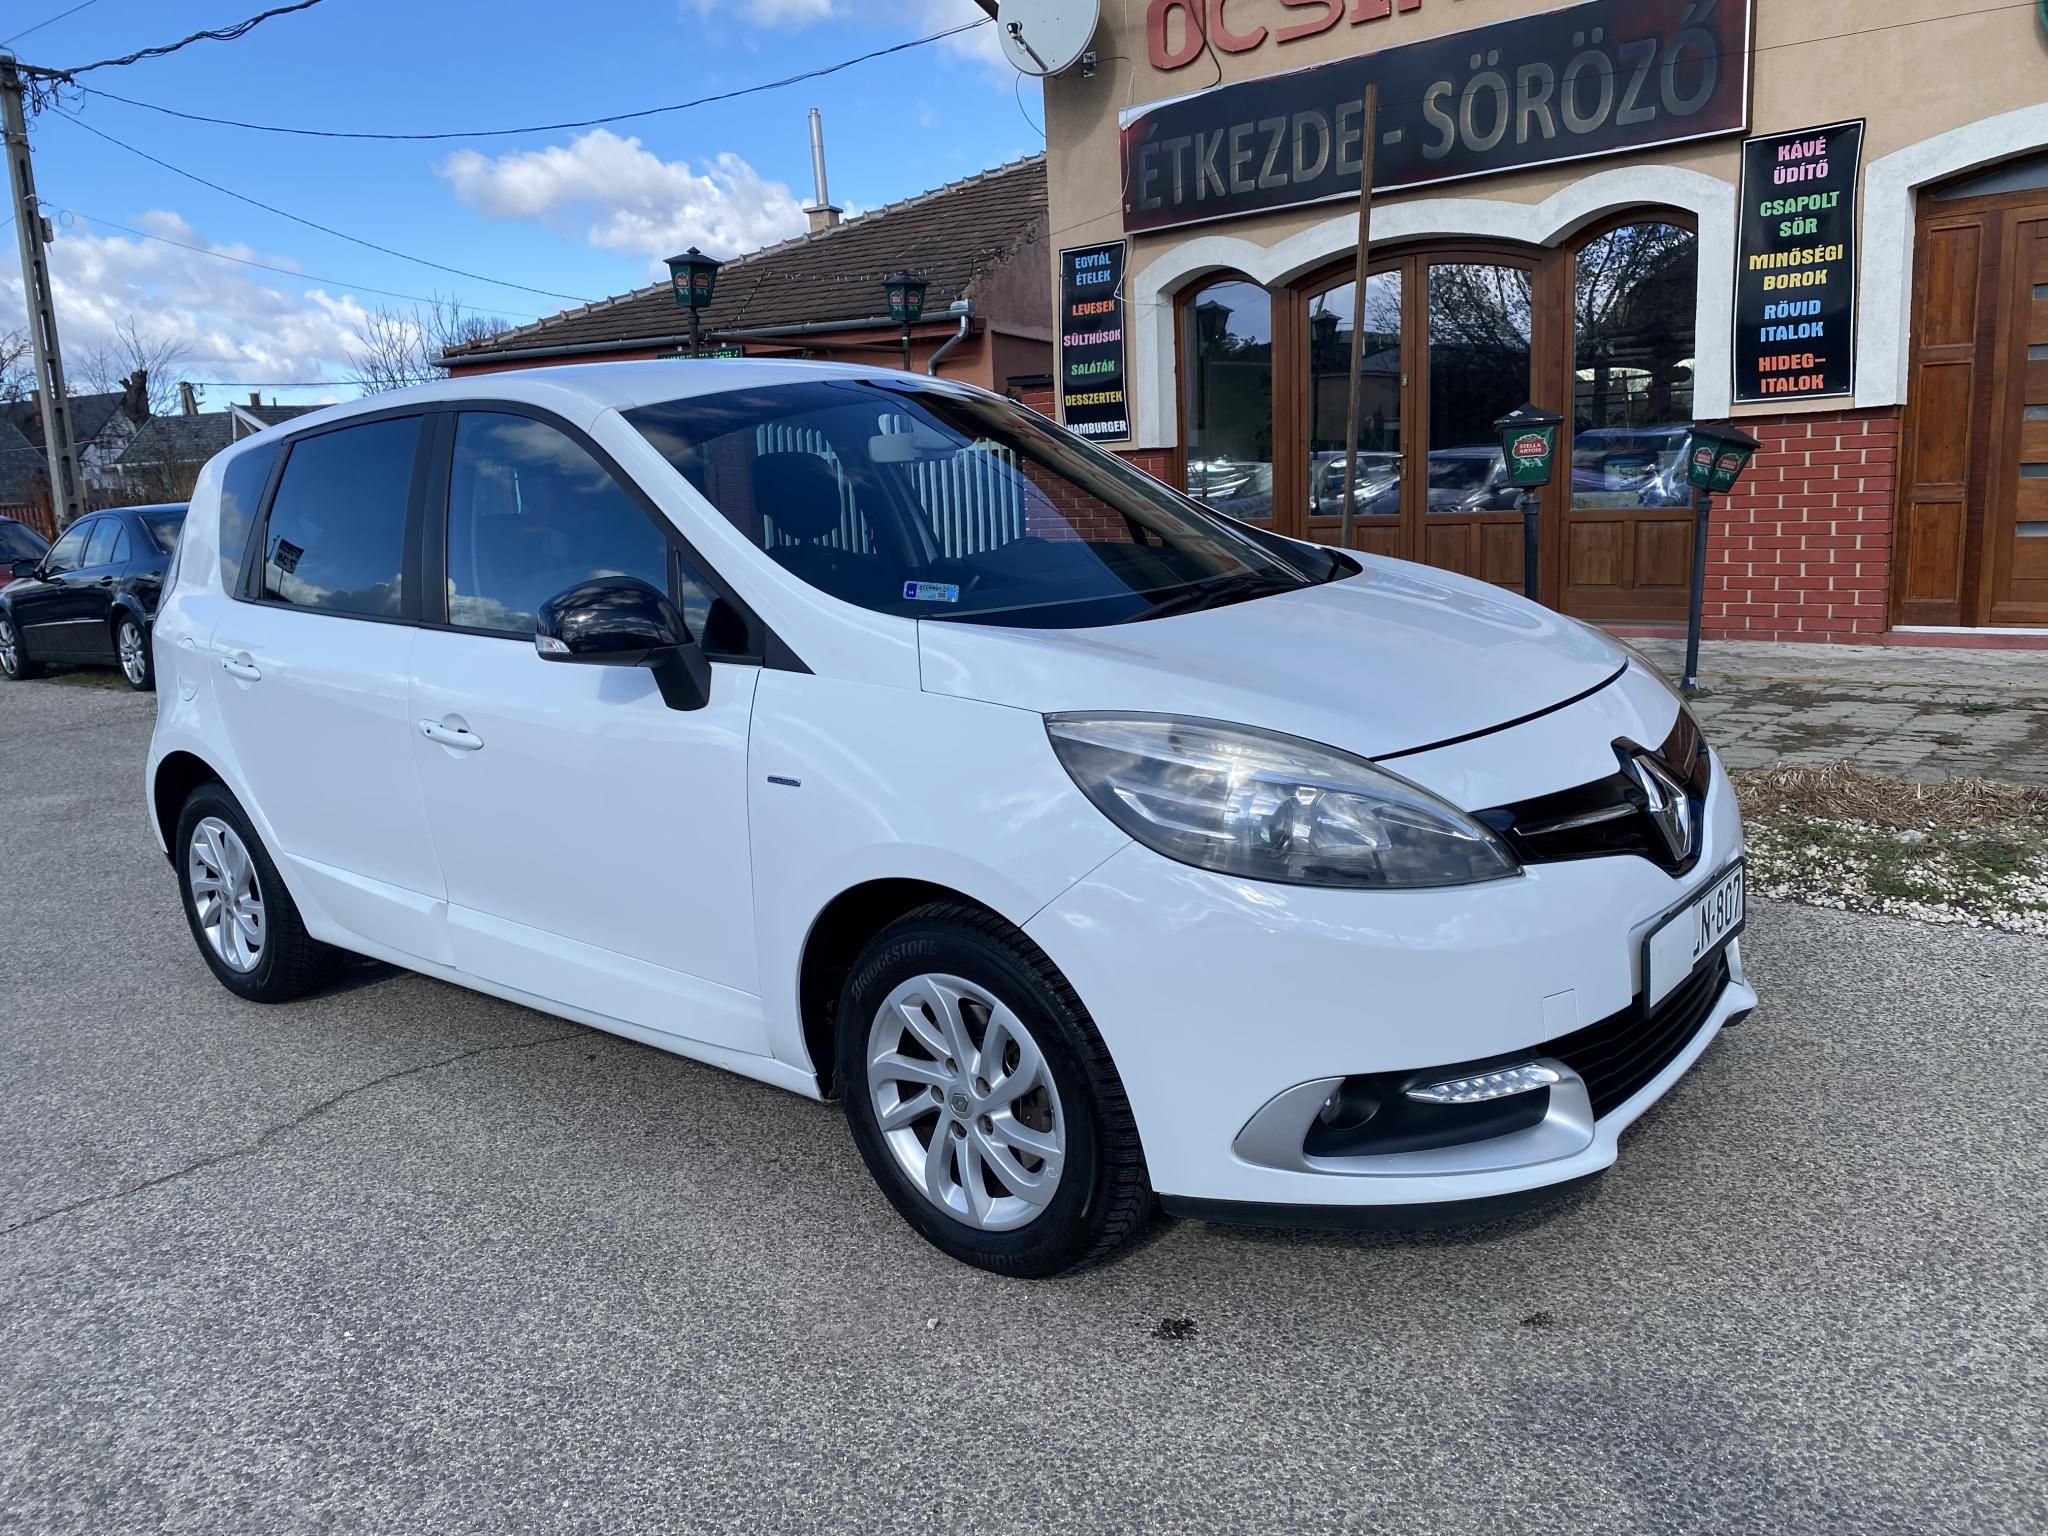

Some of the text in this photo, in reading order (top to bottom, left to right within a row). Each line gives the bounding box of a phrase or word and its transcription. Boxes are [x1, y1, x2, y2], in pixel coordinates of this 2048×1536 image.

[1139, 100, 1367, 211] ÉTKEZDE
[1422, 0, 1719, 161] SÖRÖZŐ
[1778, 138, 1827, 161] KÁVÉ
[1773, 159, 1829, 185] ÜDÍTŐ
[1760, 191, 1840, 217] CSAPOLT
[1779, 217, 1817, 237] SÖR
[1075, 251, 1111, 269] EGYTÁL
[1749, 244, 1843, 270] MINŐSÉGI
[1076, 269, 1111, 286] ÉTELEK
[1763, 269, 1828, 291] BOROK
[1072, 299, 1115, 316] LEVESEK
[1764, 299, 1821, 320] RÖVID
[1063, 328, 1121, 347] SÜLTHÚSOK
[1760, 321, 1824, 342] ITALOK
[1071, 360, 1115, 376] SALÁTÁK
[1760, 374, 1824, 393] ITALOK
[1065, 390, 1123, 407] DESSZERTEK
[1693, 873, 1740, 957] N-807
